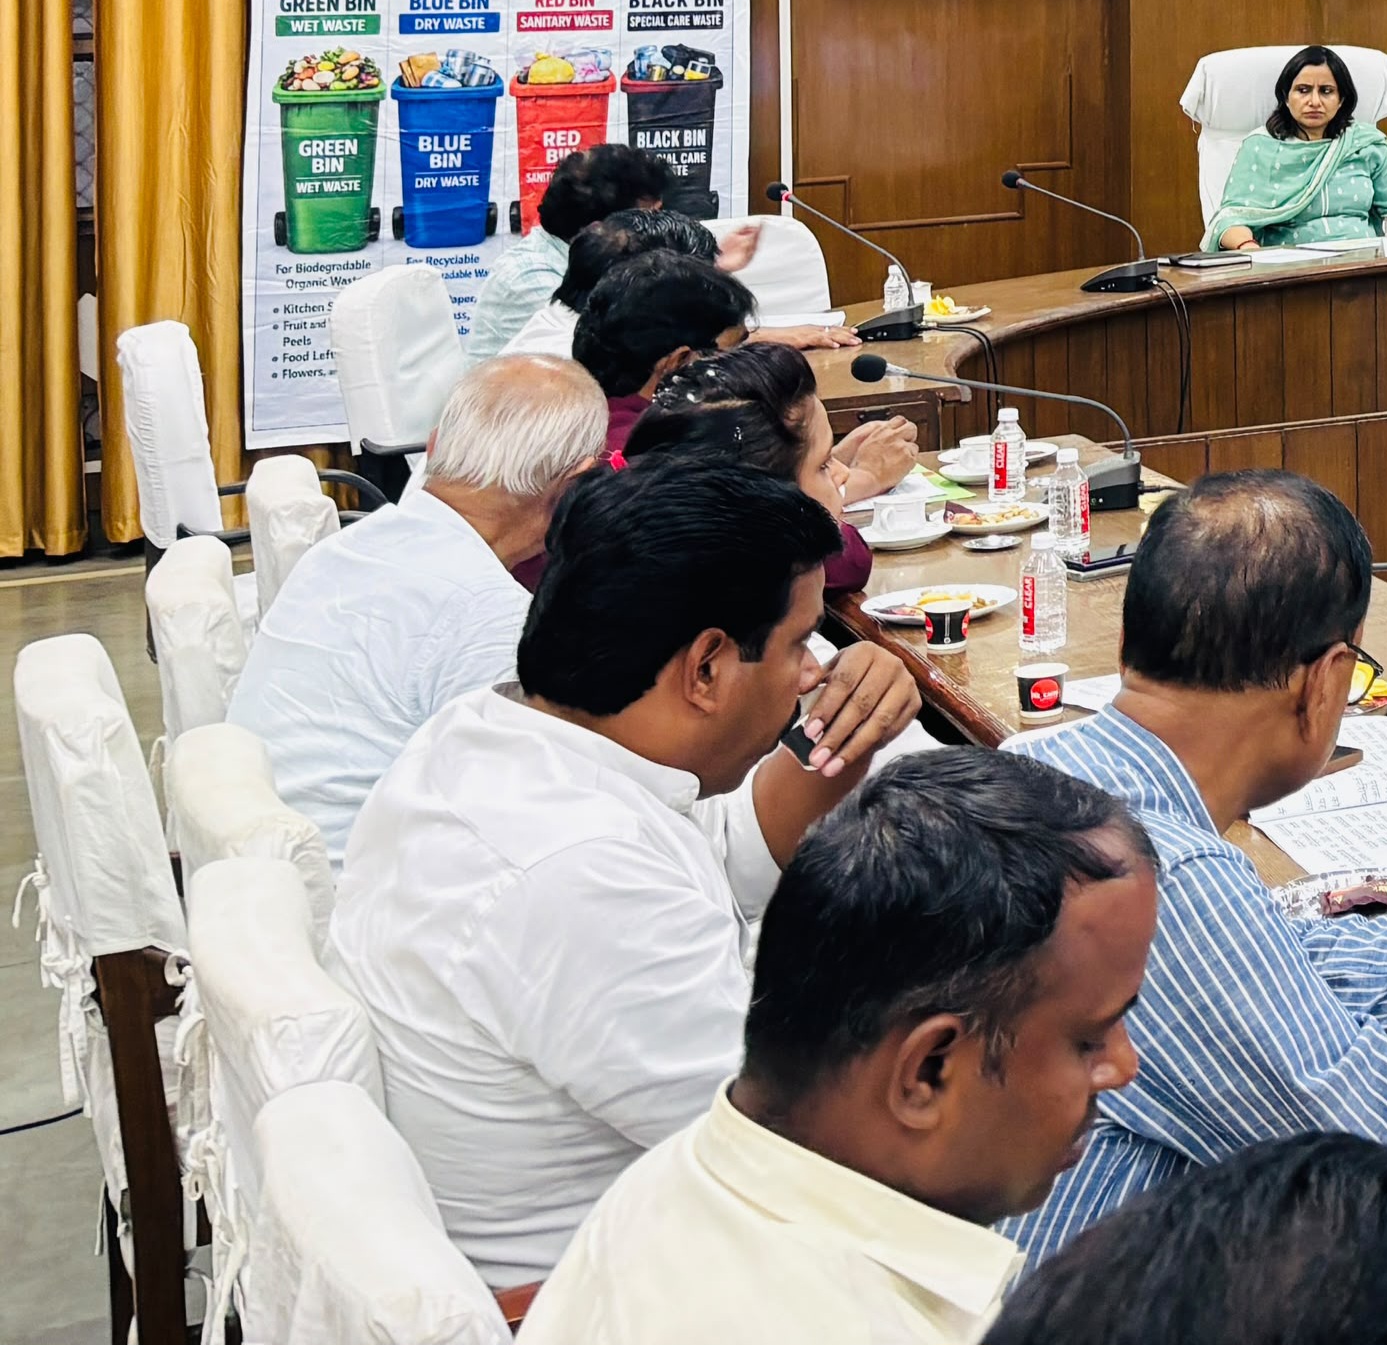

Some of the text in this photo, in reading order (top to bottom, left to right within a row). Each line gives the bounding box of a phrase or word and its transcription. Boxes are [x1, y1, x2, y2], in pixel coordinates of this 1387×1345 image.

[291, 18, 366, 33] WET WASTE
[414, 17, 485, 31] DRY WASTE
[520, 14, 610, 28] SANITARY WASTE
[629, 13, 721, 27] SPECIAL CARE WASTE
[418, 134, 472, 152] BLUE
[543, 130, 581, 147] RED
[637, 129, 706, 148] BLACK BIN
[299, 139, 358, 157] GREEN
[429, 153, 462, 169] BIN
[680, 152, 706, 164] CARE
[312, 158, 344, 174] BIN
[415, 175, 479, 189] DRY WASTE
[526, 172, 554, 184] SANIT
[296, 180, 361, 194] WET WASTE
[276, 260, 371, 275] For Biodegradable
[426, 253, 480, 268] Recyclable
[286, 278, 327, 291] Organic
[283, 304, 325, 315] Kitchen
[283, 320, 327, 330] Fruit and
[283, 335, 312, 346] Peels
[282, 352, 309, 362] Food
[282, 367, 327, 379] Flowers,
[995, 443, 1004, 468] CLEAR
[1080, 483, 1088, 512] CLEAR
[1024, 577, 1033, 608] CLEAR
